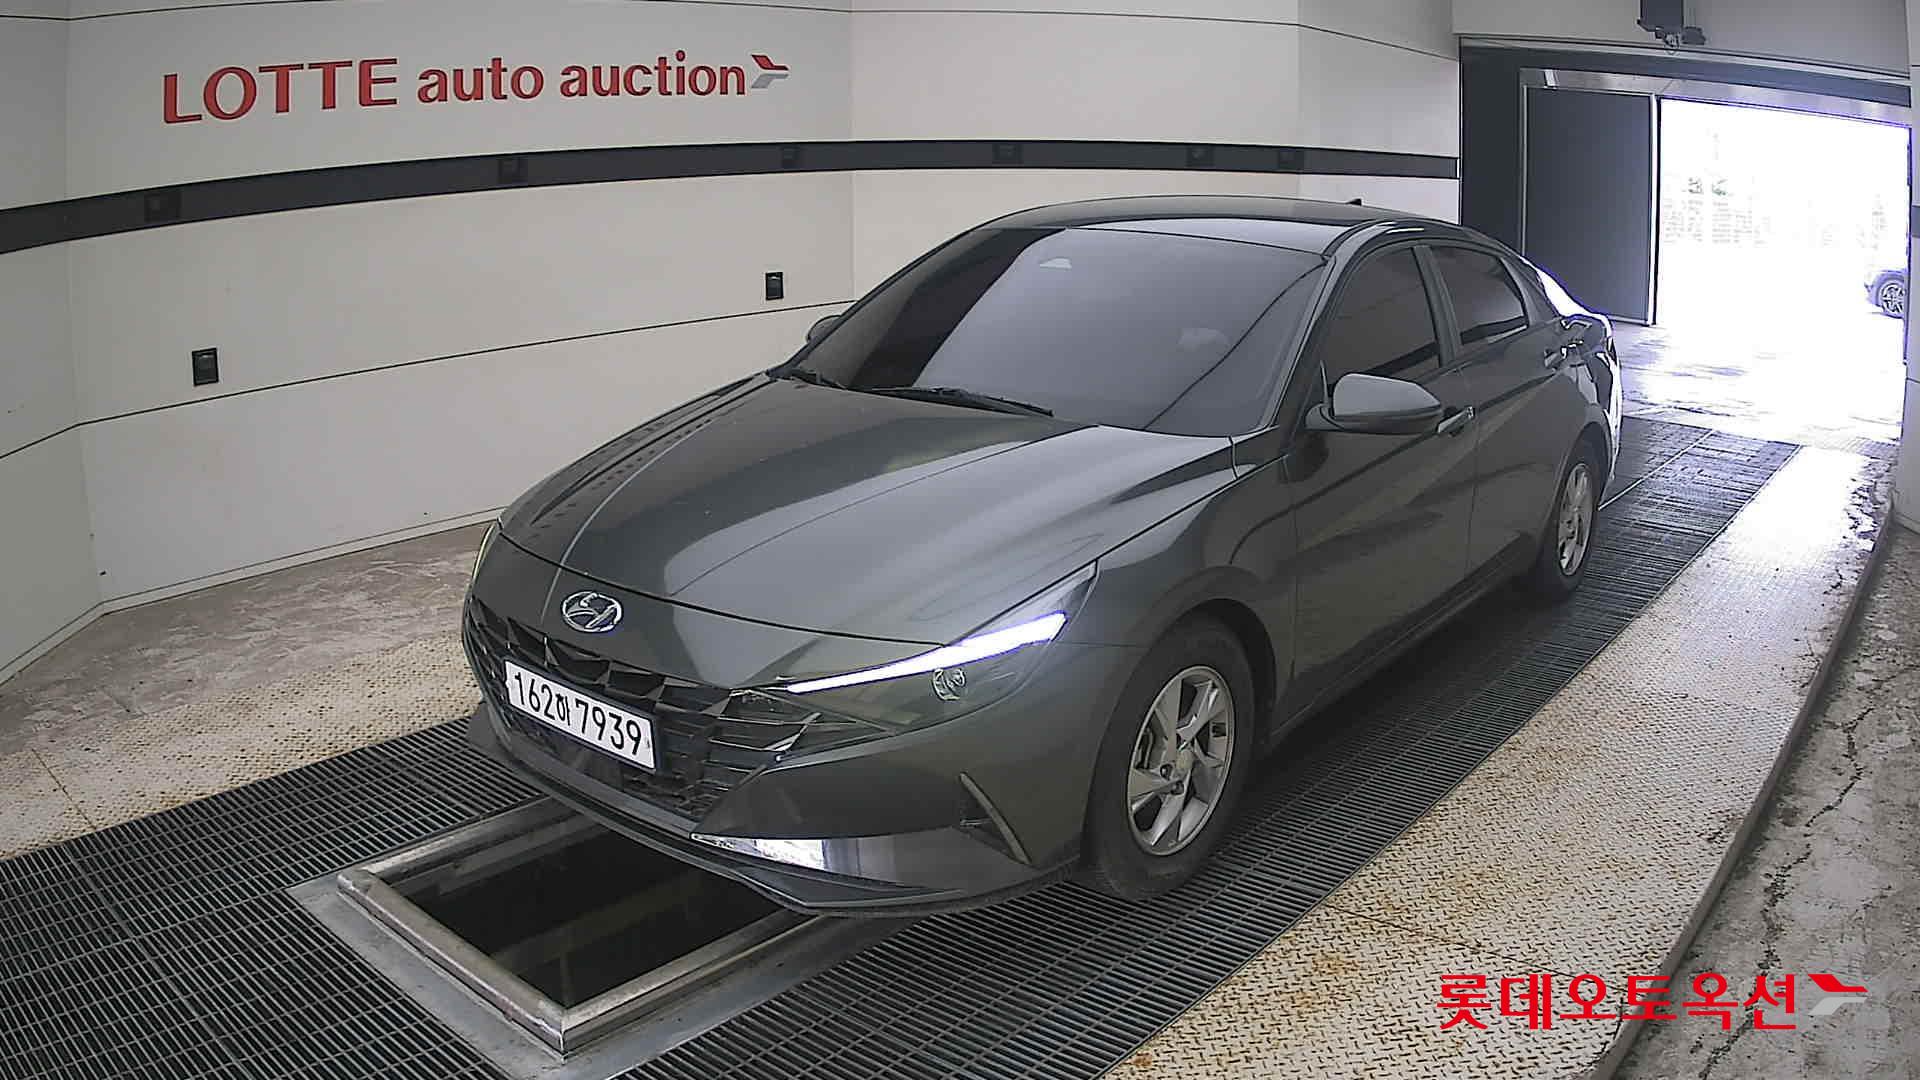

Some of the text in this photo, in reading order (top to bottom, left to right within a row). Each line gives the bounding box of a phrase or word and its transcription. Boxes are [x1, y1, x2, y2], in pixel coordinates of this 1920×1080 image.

[163, 50, 746, 124] LOTTE auto auction
